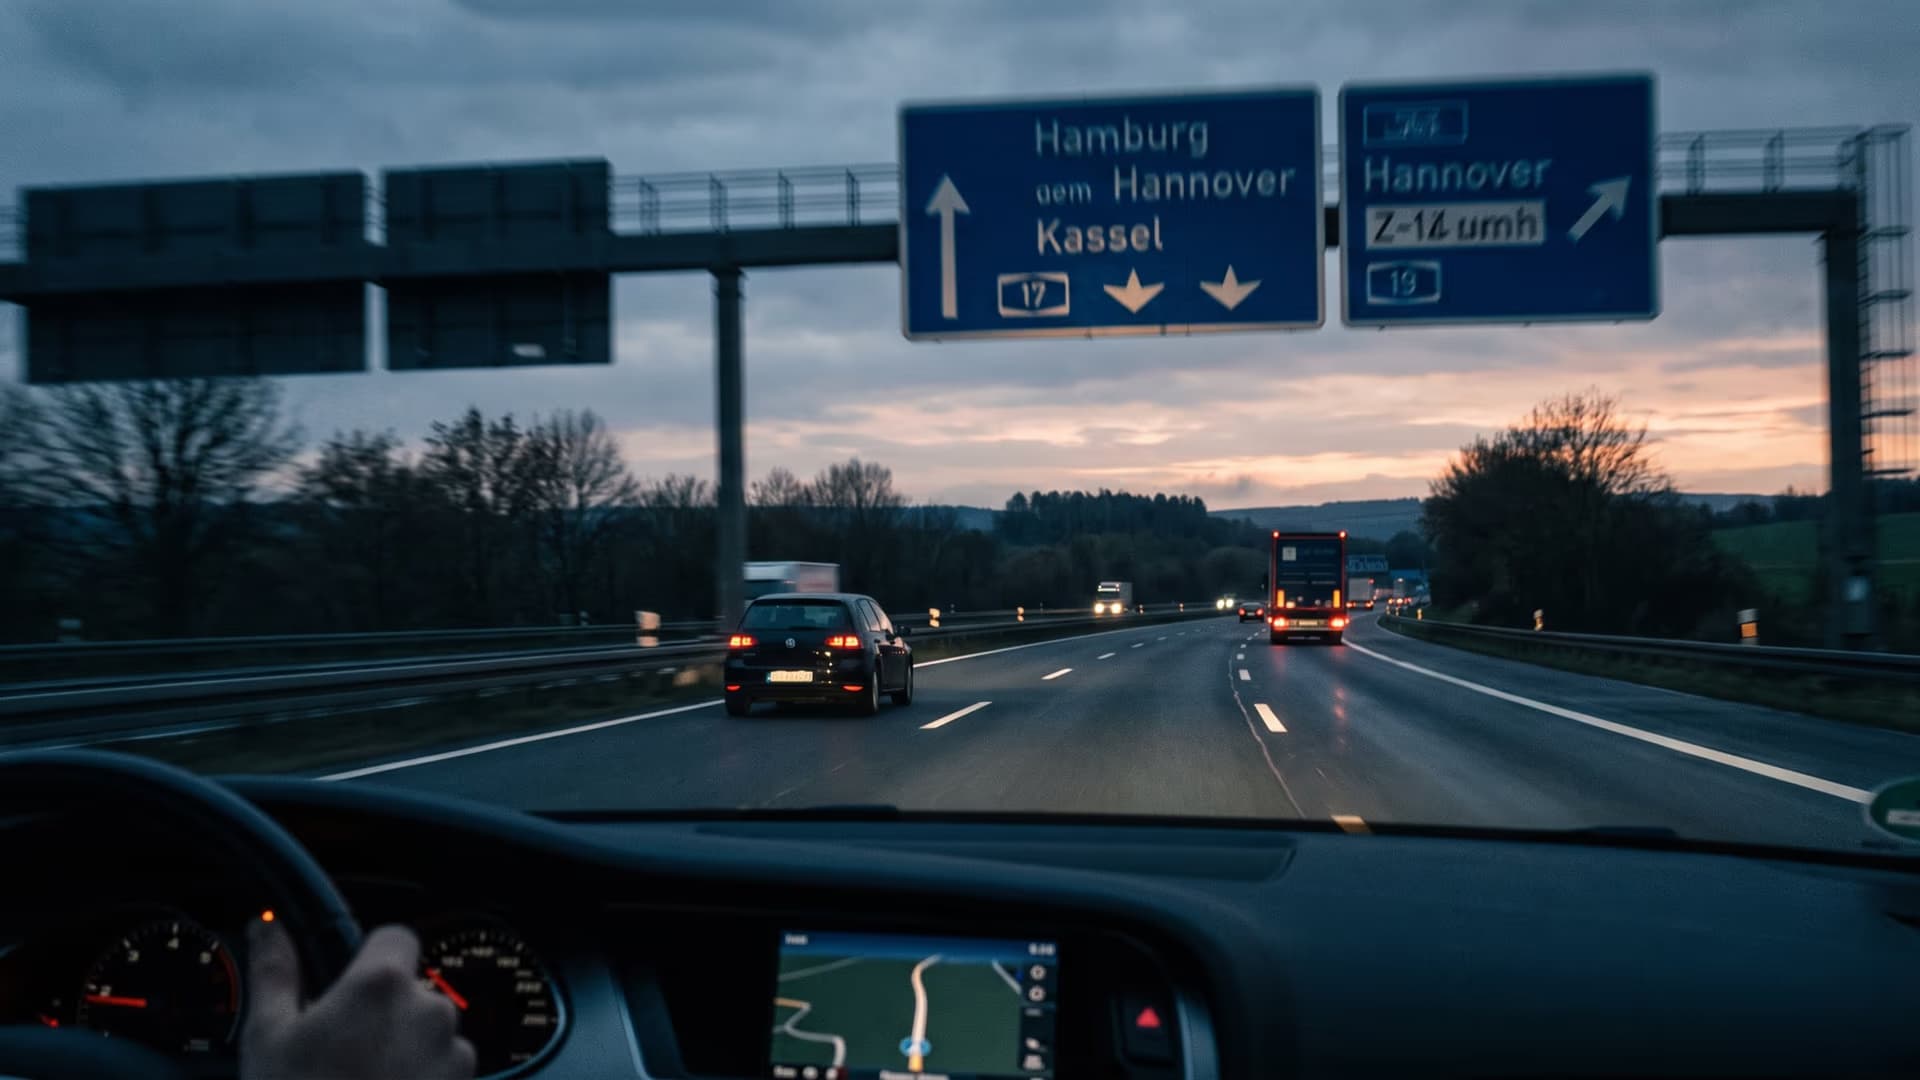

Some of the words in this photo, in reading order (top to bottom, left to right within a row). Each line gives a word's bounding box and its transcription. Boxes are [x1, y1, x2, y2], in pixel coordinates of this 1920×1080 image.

[1035, 114, 1209, 158] Hamburg
[1113, 164, 1297, 204] Hannover
[1364, 156, 1552, 192] Hannover
[1036, 215, 1164, 256] Kassel
[1021, 282, 1047, 309] 17
